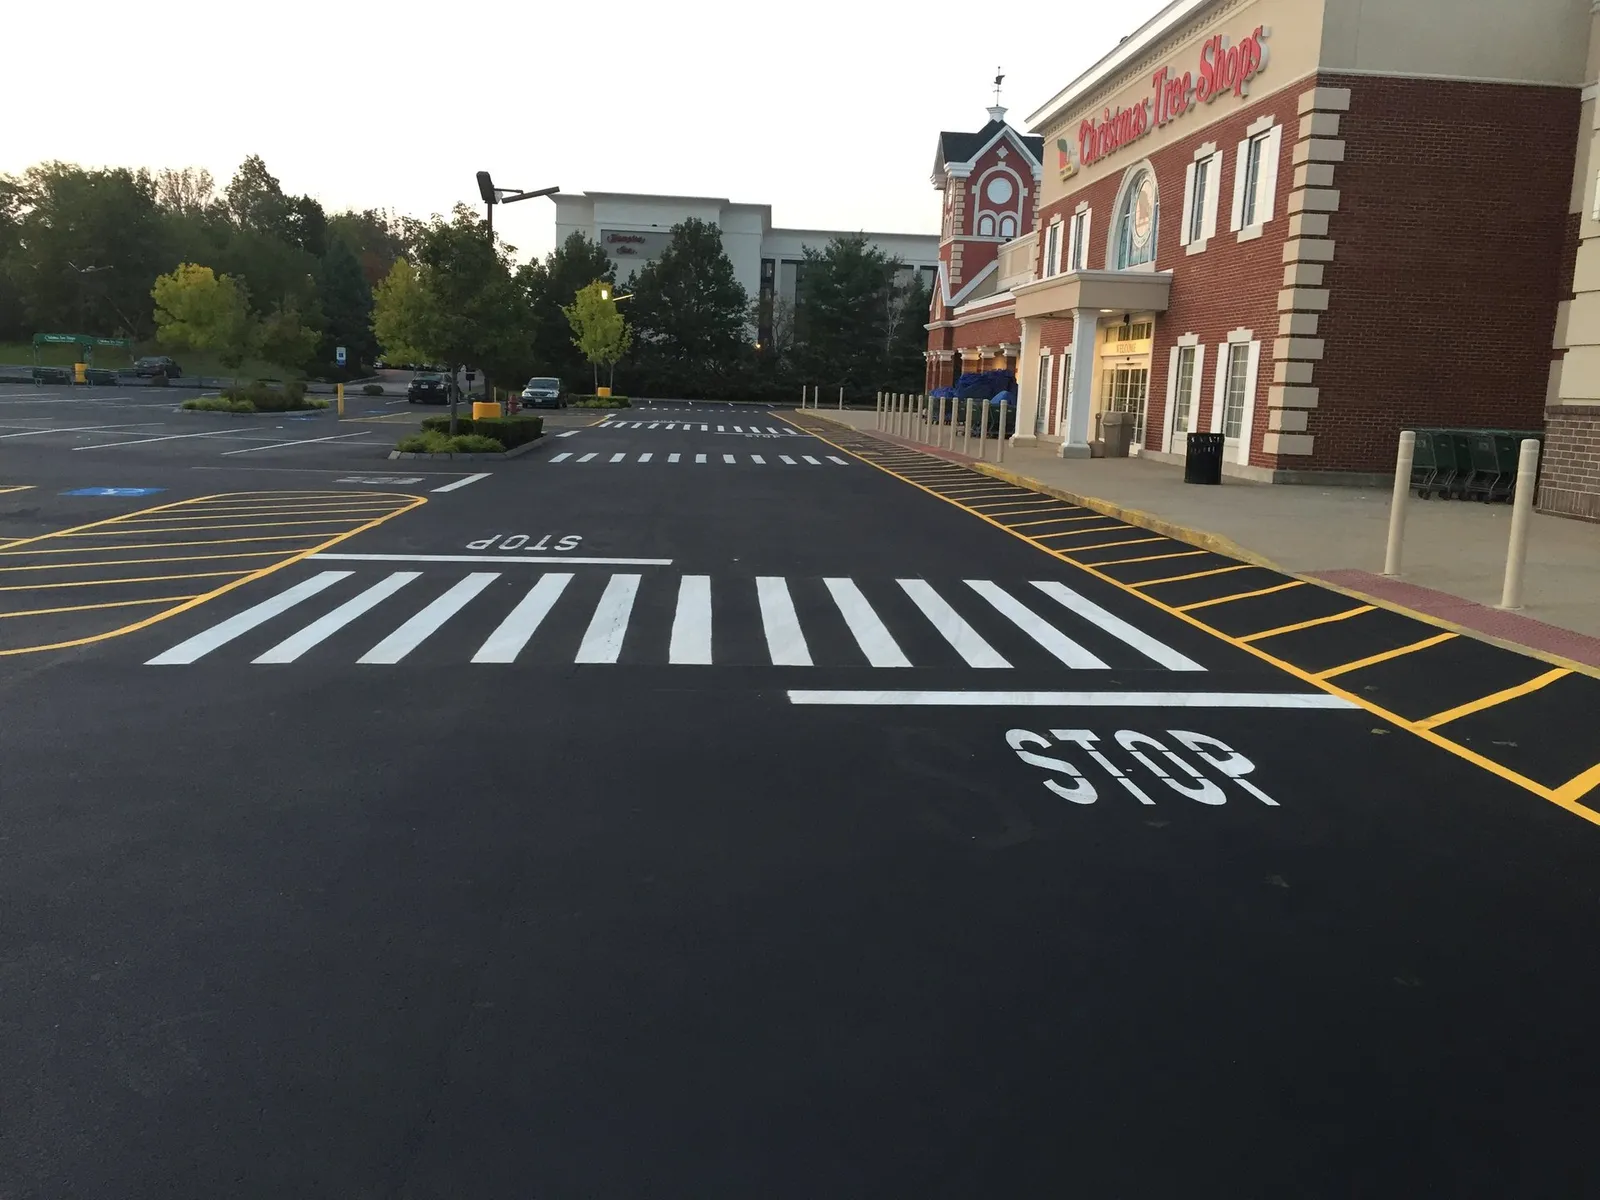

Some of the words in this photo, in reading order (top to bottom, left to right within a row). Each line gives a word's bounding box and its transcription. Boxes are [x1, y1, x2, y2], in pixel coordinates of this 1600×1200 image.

[1079, 97, 1149, 166] Christmas
[1152, 66, 1192, 126] Tree
[1196, 25, 1265, 103] Shops
[465, 533, 584, 551] STOP
[1005, 728, 1281, 806] STOP
